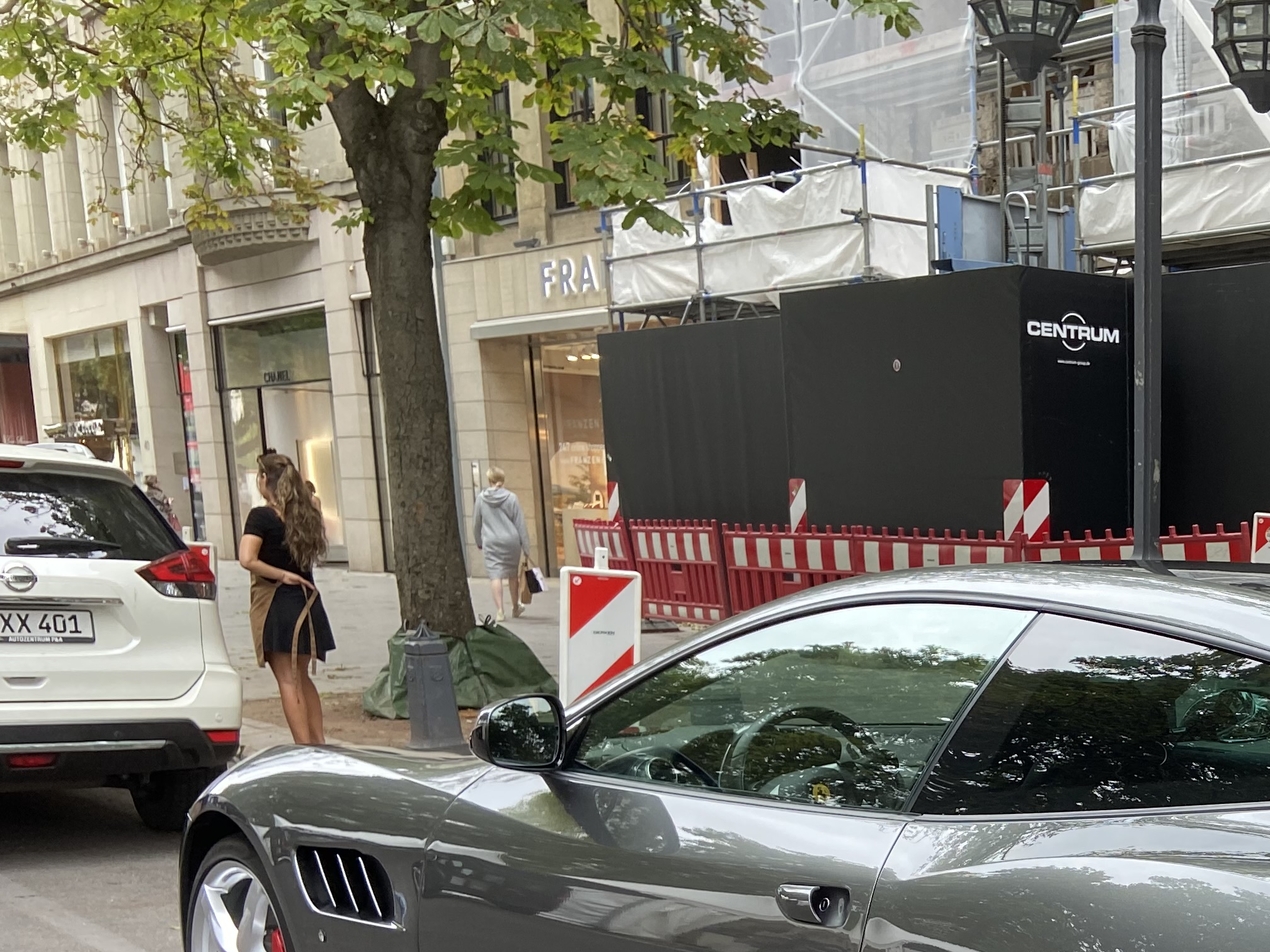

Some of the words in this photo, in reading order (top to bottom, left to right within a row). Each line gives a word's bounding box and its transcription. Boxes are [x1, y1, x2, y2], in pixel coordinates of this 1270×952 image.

[1026, 320, 1120, 343] CENTRUM
[0, 613, 31, 633] XX
[38, 613, 82, 633] 401
